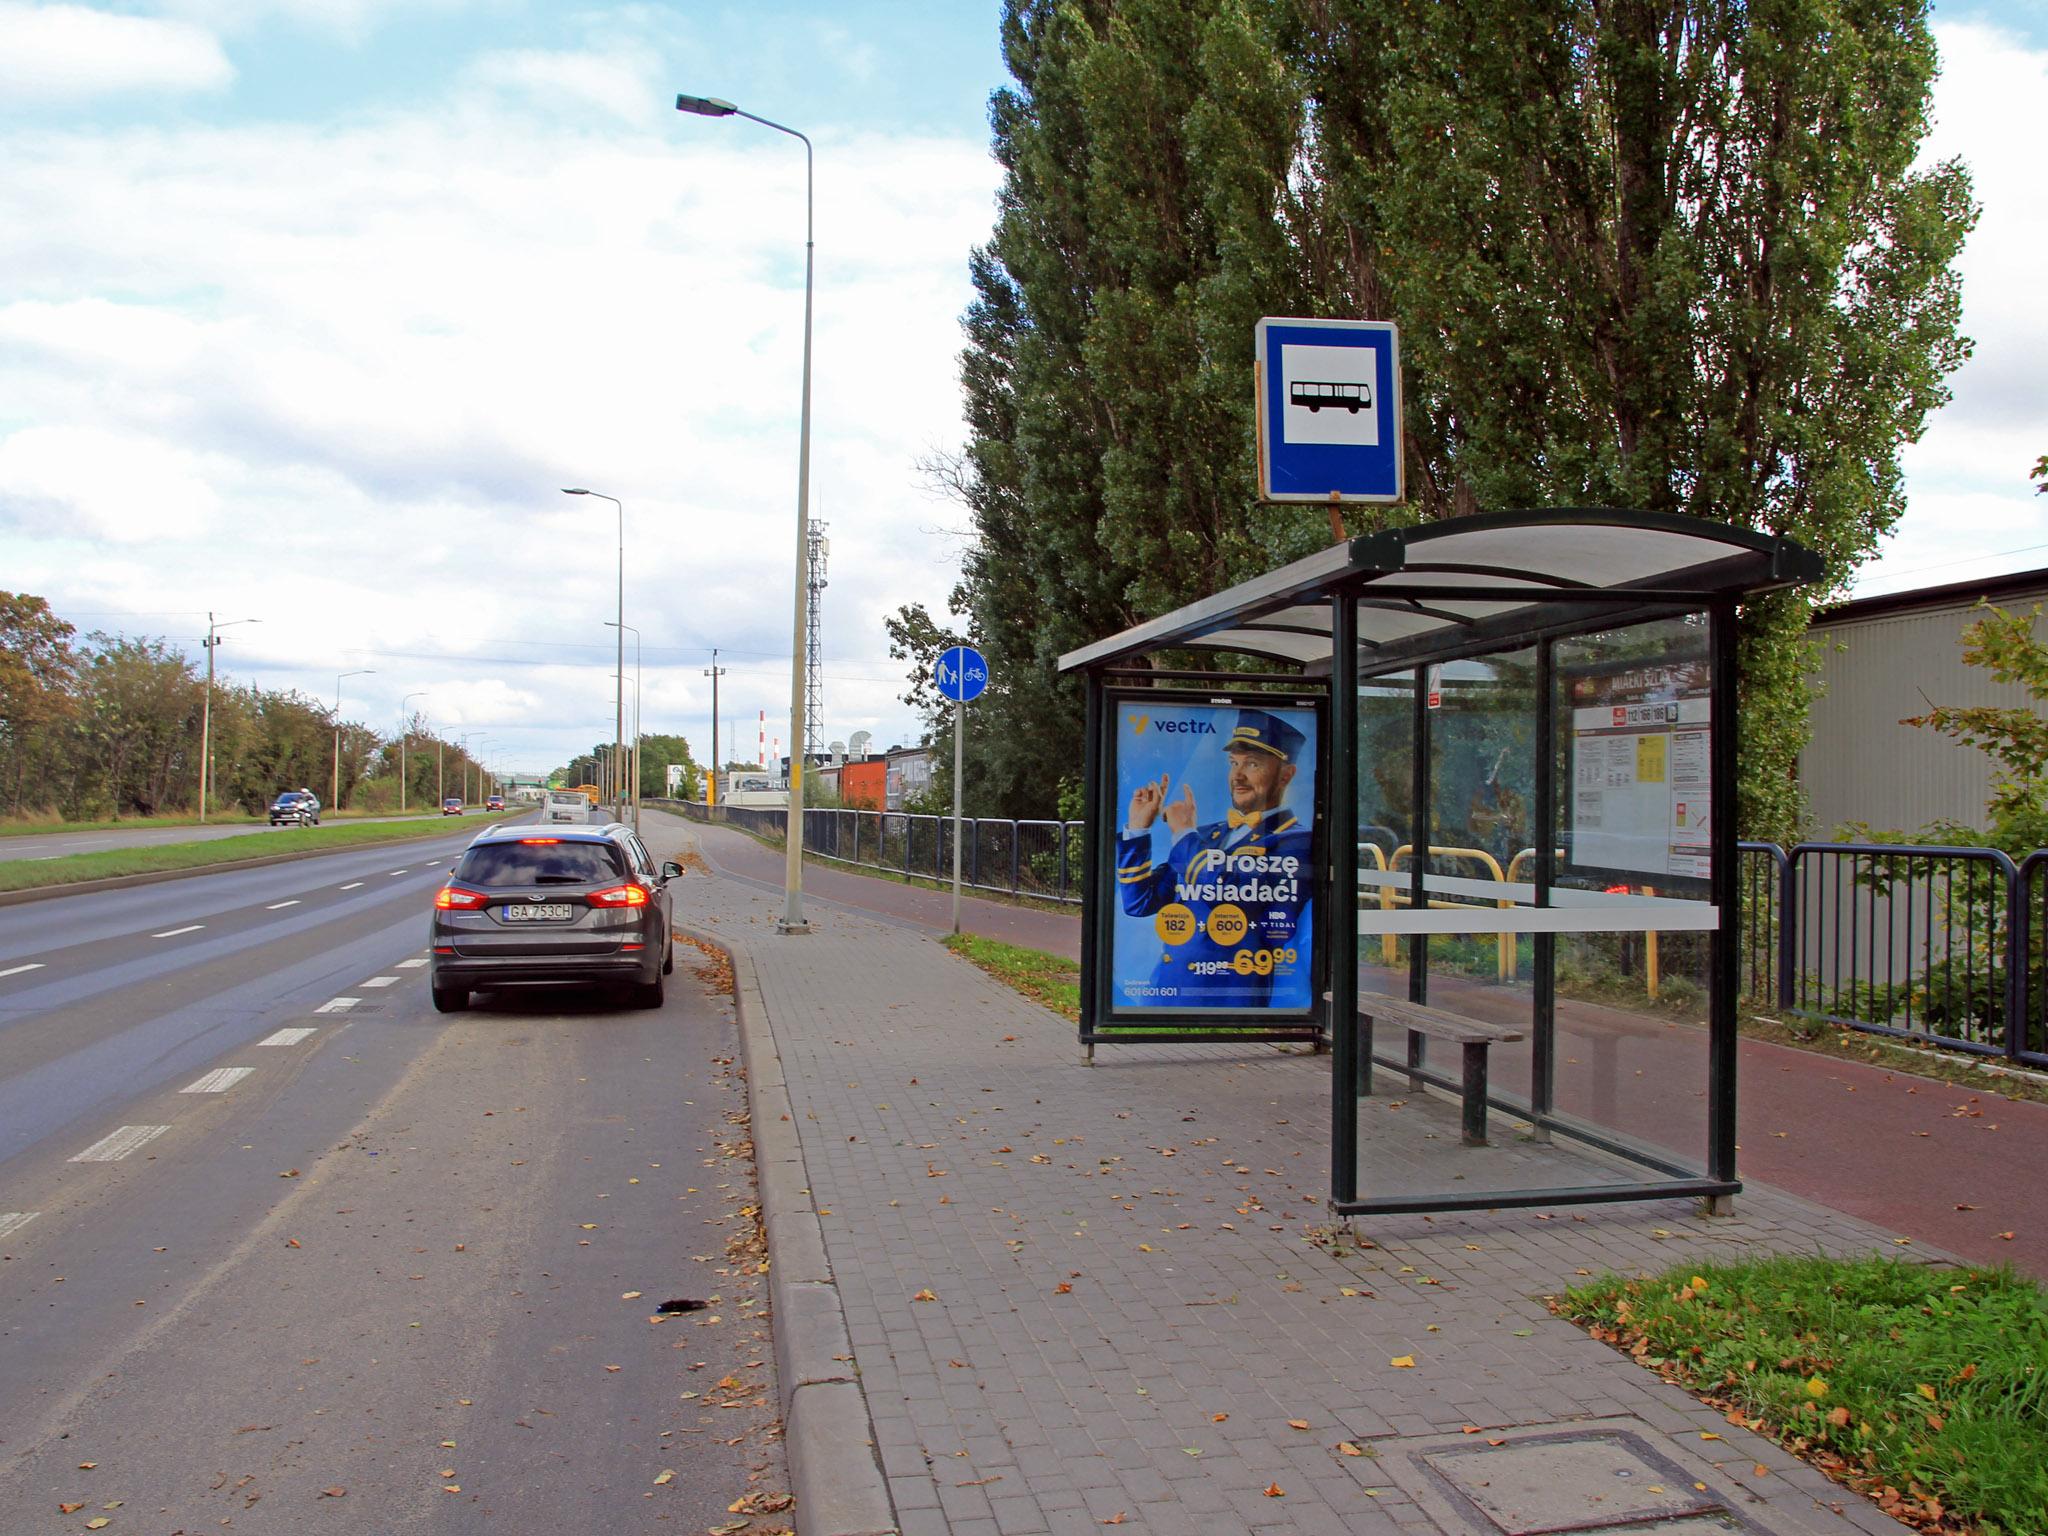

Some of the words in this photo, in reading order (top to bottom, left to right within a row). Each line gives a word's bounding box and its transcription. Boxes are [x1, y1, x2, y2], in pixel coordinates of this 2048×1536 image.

[1206, 848, 1300, 879] Proszę
[1178, 877, 1298, 902] wsiadać!
[511, 905, 529, 918] GA
[533, 905, 571, 918] 753CH
[1268, 911, 1287, 920] HBO
[1164, 920, 1186, 931] 182
[1215, 920, 1243, 932] 600
[1124, 987, 1142, 997] 601
[1142, 987, 1160, 997] 601
[1160, 987, 1178, 997] 601
